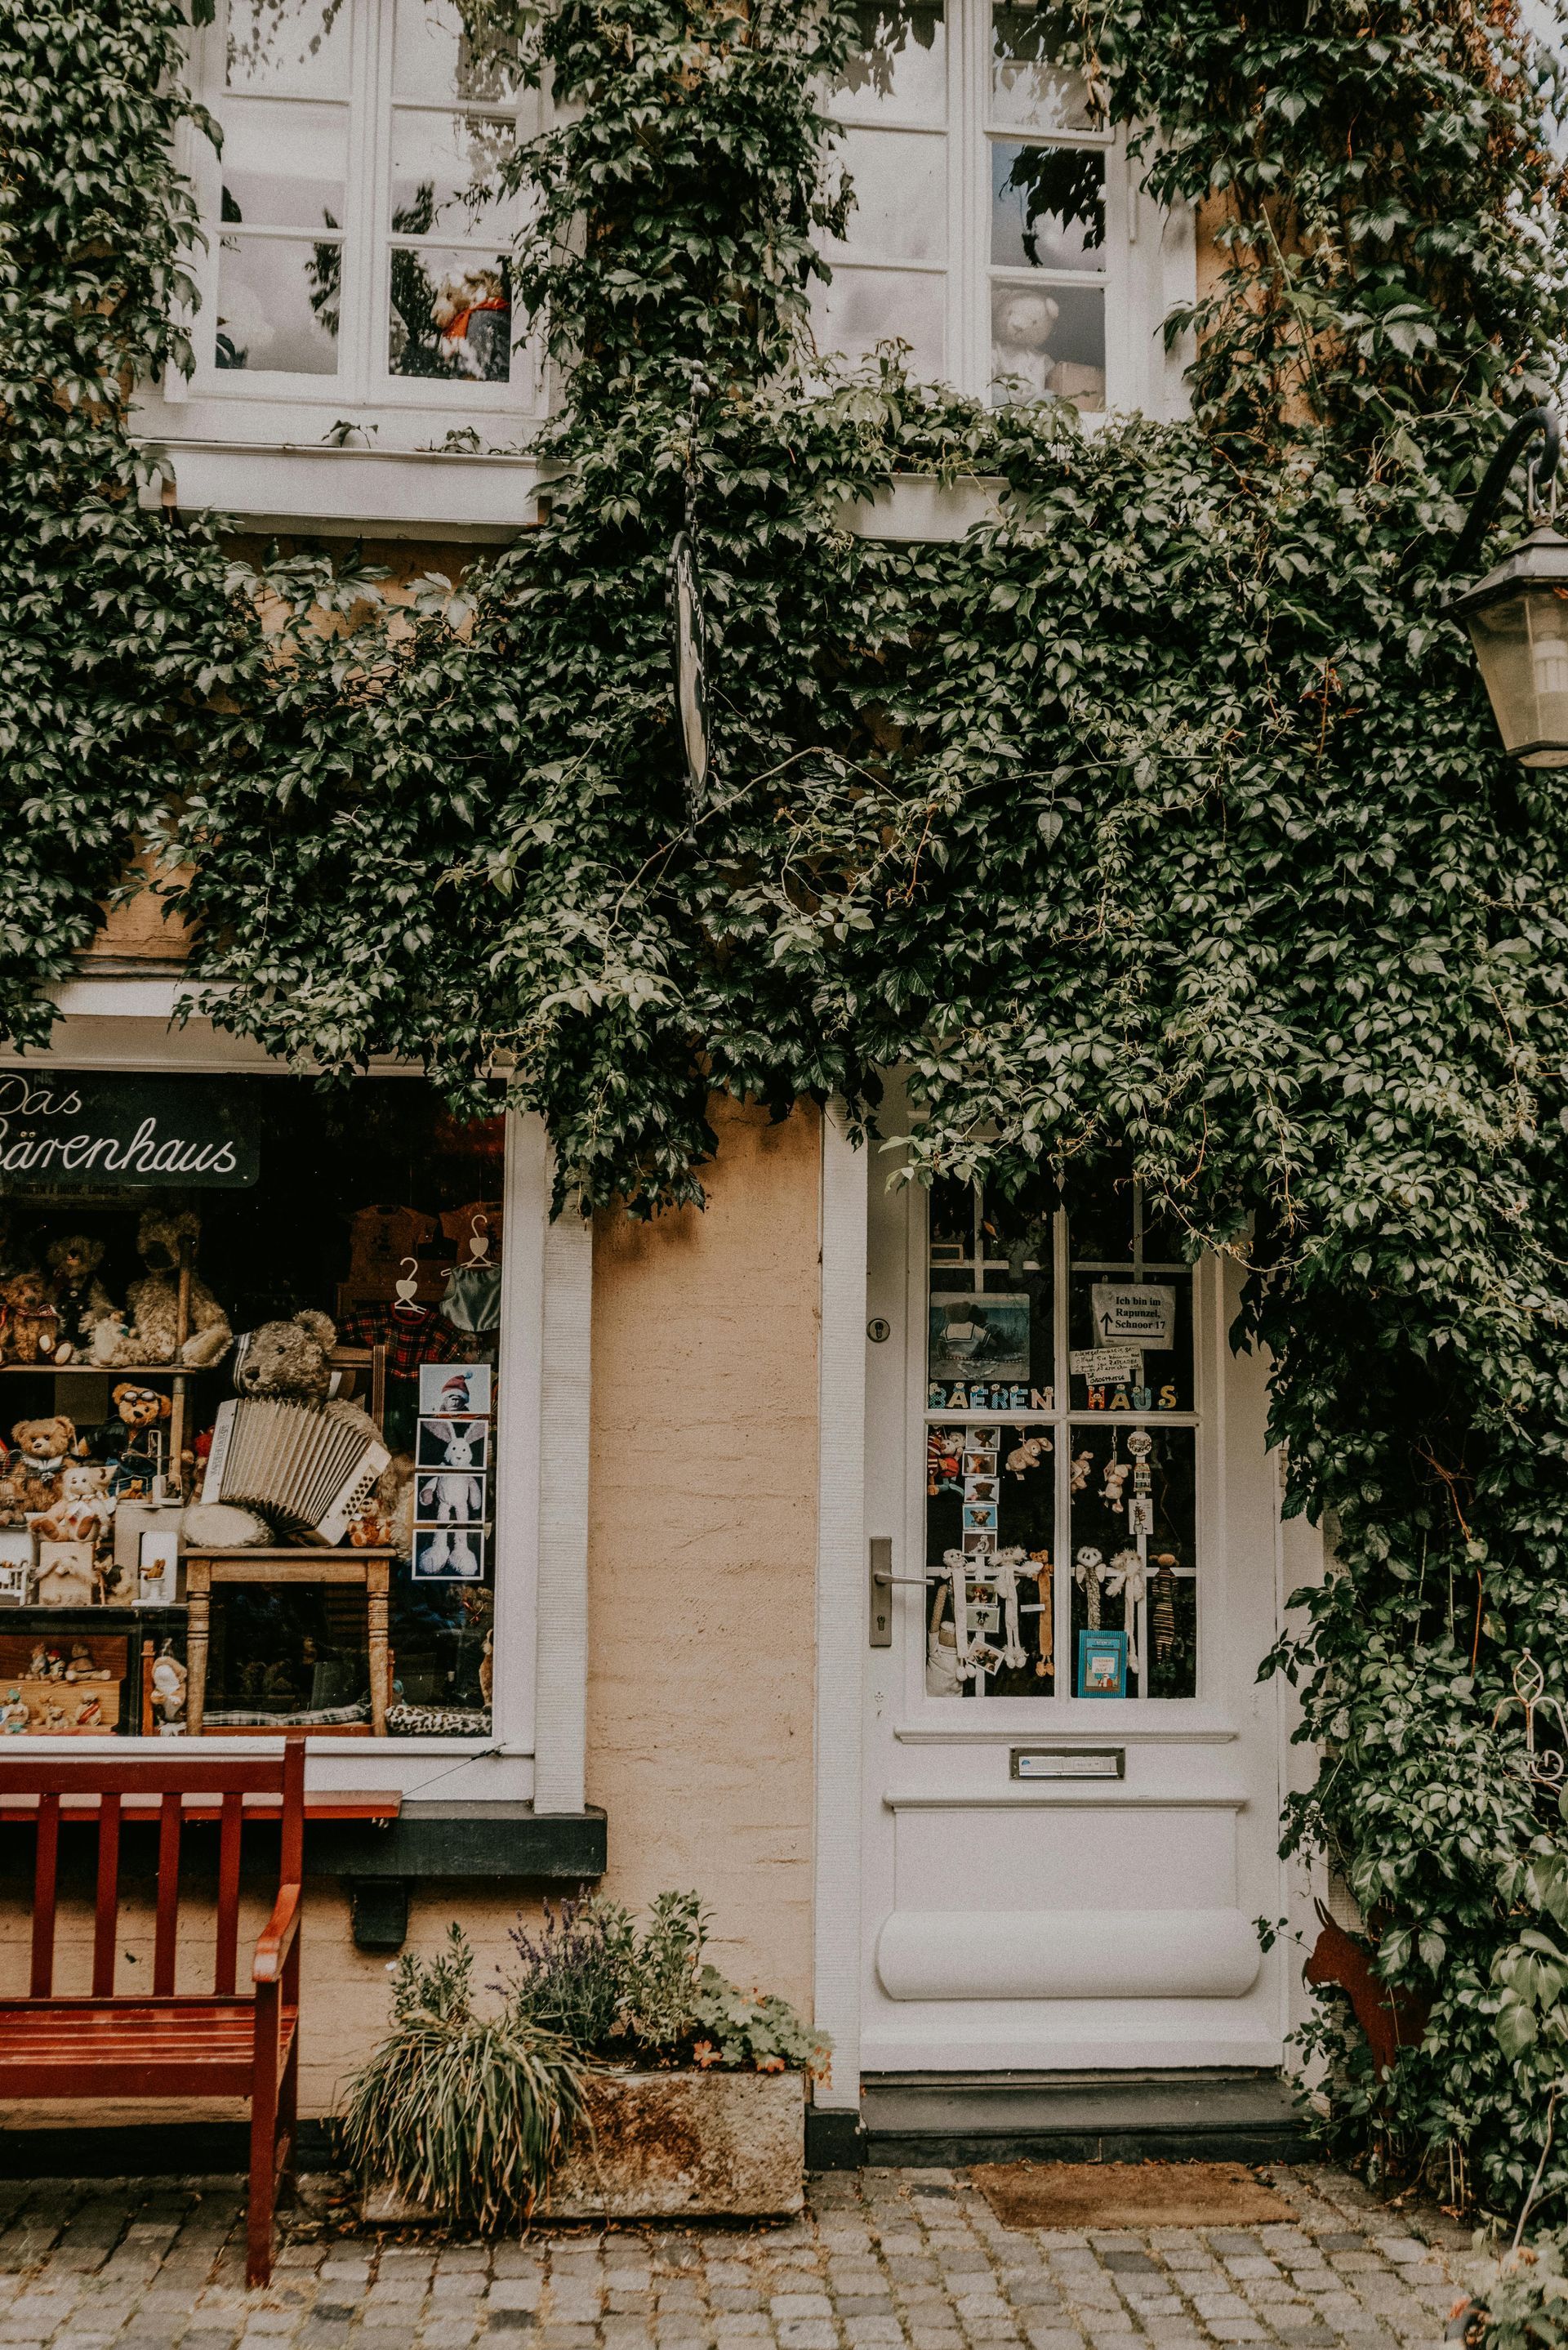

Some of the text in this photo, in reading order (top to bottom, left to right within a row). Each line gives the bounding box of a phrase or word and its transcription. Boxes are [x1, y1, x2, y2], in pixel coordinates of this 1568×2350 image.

[0, 1073, 82, 1116] Das
[0, 1117, 237, 1173] ärenhaus
[1116, 1296, 1161, 1306] Ich bin im
[1116, 1308, 1160, 1319] Rapunzel,
[1115, 1320, 1165, 1329] Schnoor 17
[929, 1383, 1177, 1411] BAEREN HAUS
